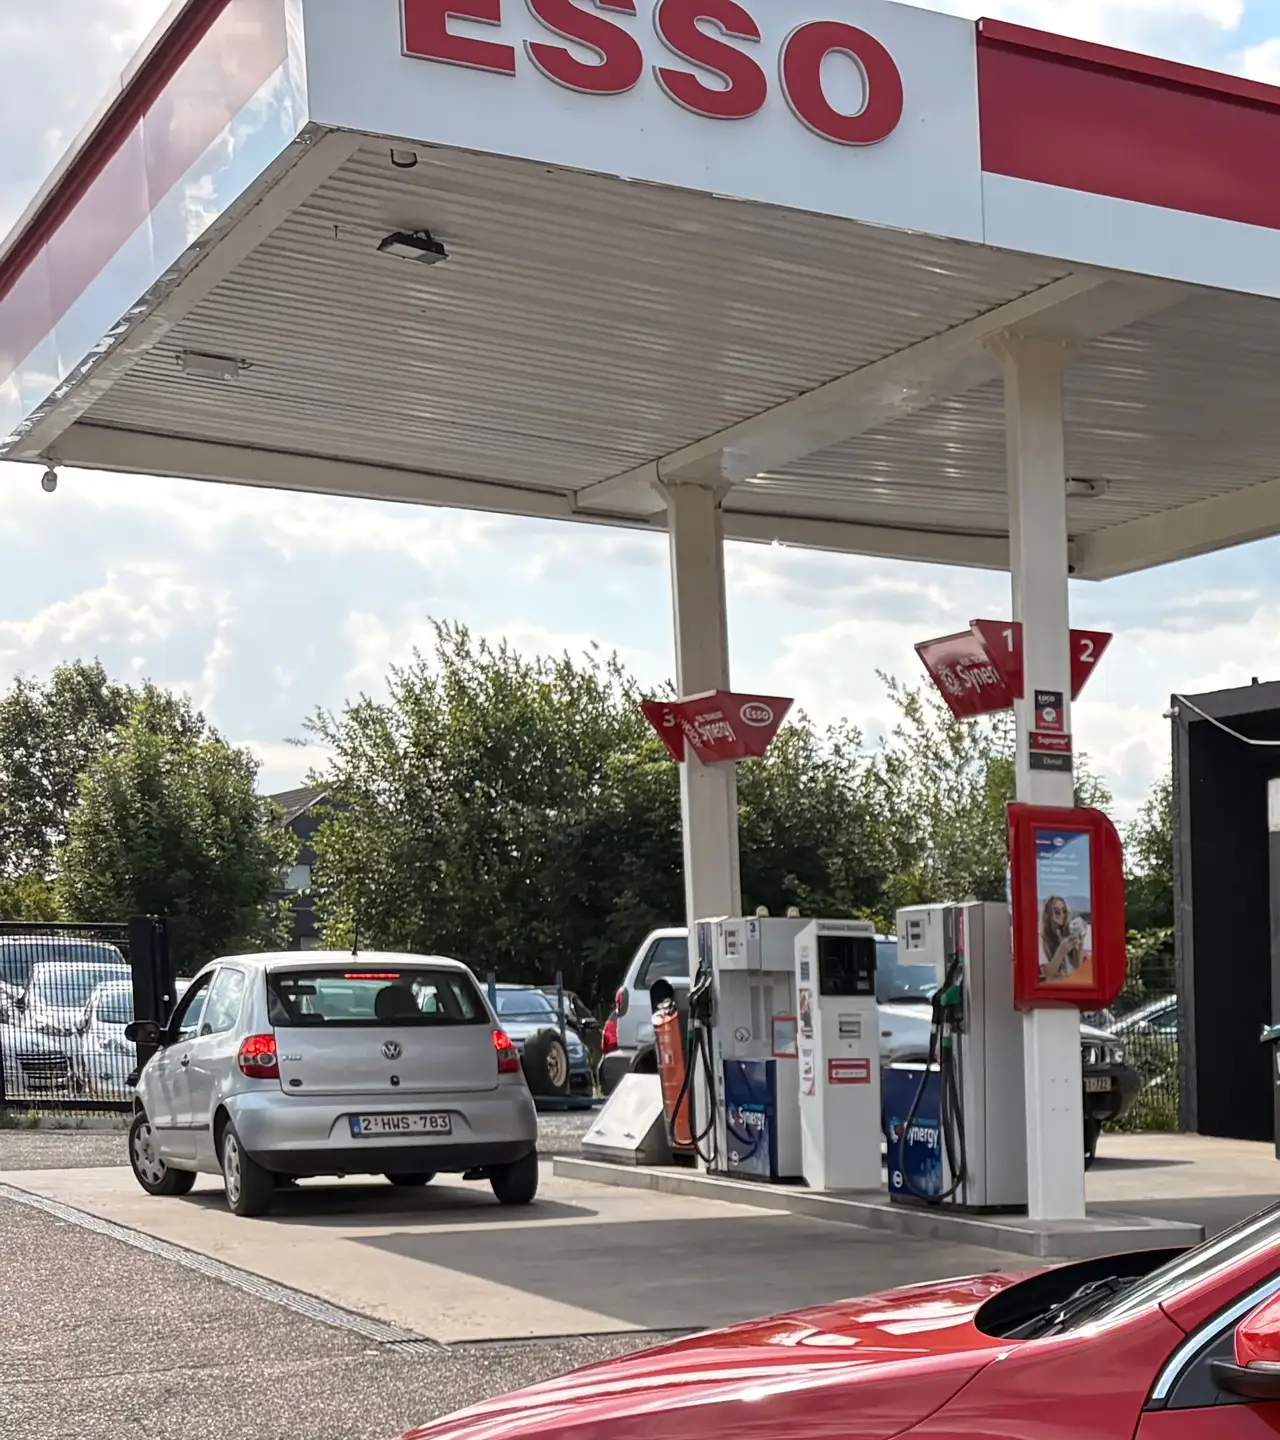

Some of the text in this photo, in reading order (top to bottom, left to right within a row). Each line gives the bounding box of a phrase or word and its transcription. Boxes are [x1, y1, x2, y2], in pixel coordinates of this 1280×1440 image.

[400, 0, 904, 146] ESSO
[1002, 629, 1014, 652] 1
[1080, 640, 1095, 663] 2
[956, 664, 1006, 694] Syner
[663, 709, 676, 727] 3
[745, 707, 769, 721] Esso
[694, 720, 737, 745] Synergy
[739, 1107, 766, 1131] Synergy
